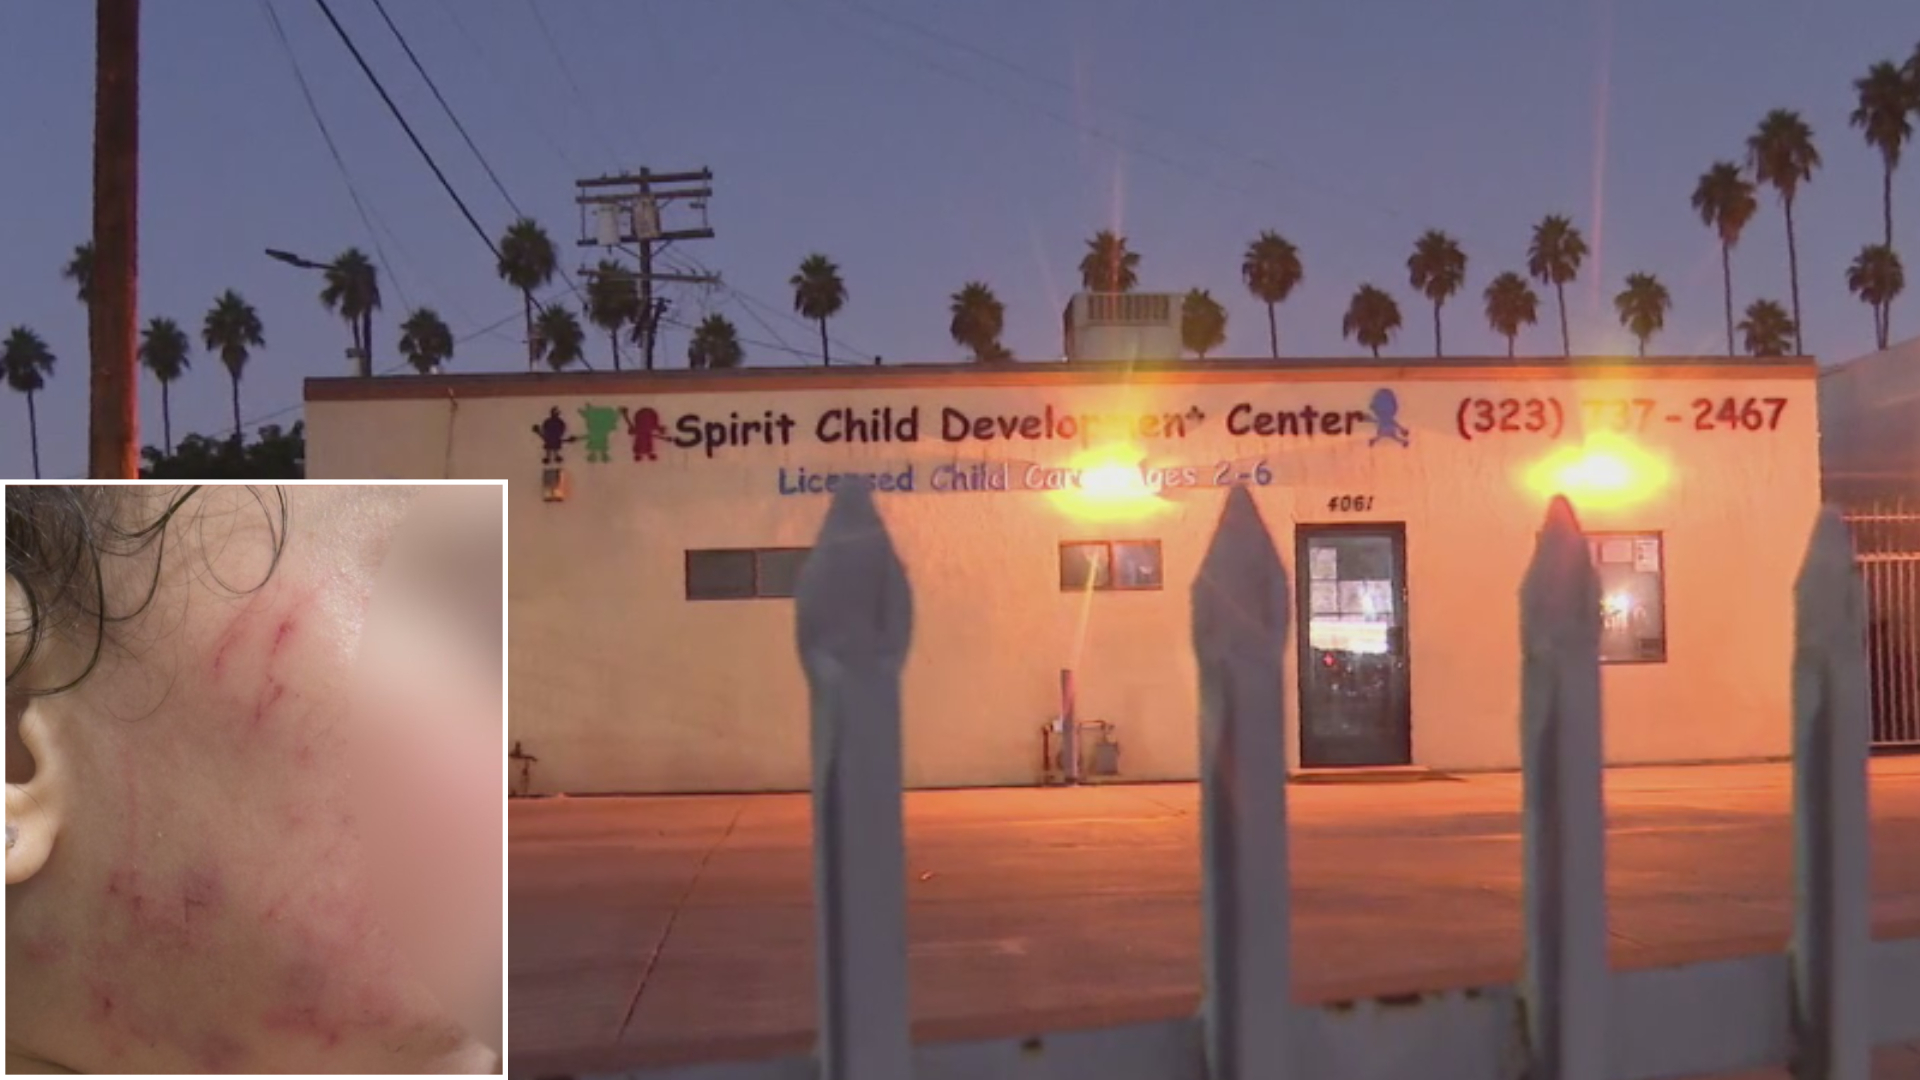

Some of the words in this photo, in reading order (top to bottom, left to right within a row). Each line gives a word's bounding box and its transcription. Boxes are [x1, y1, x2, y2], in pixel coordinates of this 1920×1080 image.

[675, 412, 796, 458] Spirit
[816, 407, 919, 444] Child
[941, 405, 1205, 449] Developen
[1227, 403, 1362, 436] Center
[1456, 397, 1564, 440] (323)
[778, 464, 914, 495] Licesed
[930, 463, 1009, 493] Child
[1025, 462, 1103, 489] Car
[1327, 494, 1374, 512] 4061
